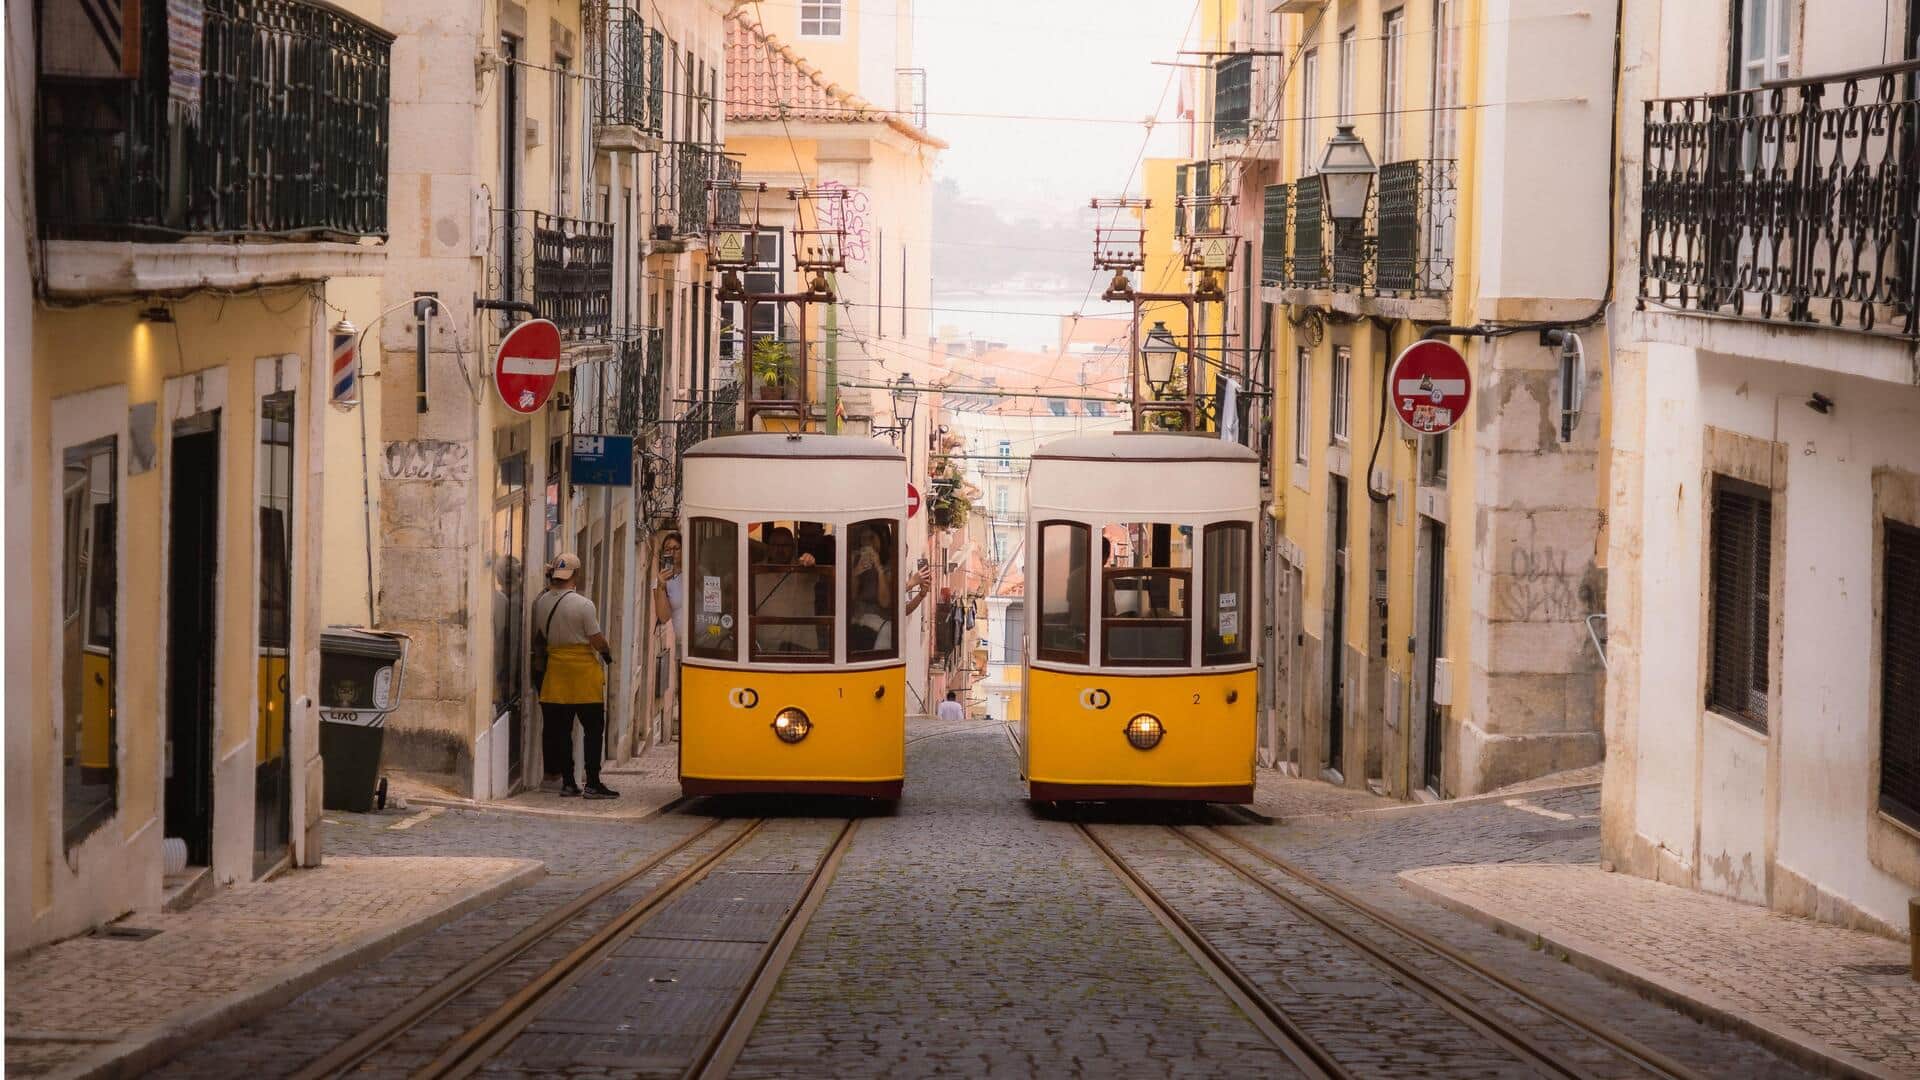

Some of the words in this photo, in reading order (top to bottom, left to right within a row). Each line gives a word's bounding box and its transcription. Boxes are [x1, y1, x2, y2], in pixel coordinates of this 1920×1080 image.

[838, 687, 843, 699] 1
[1193, 693, 1200, 705] 2
[330, 711, 358, 721] LIXO
